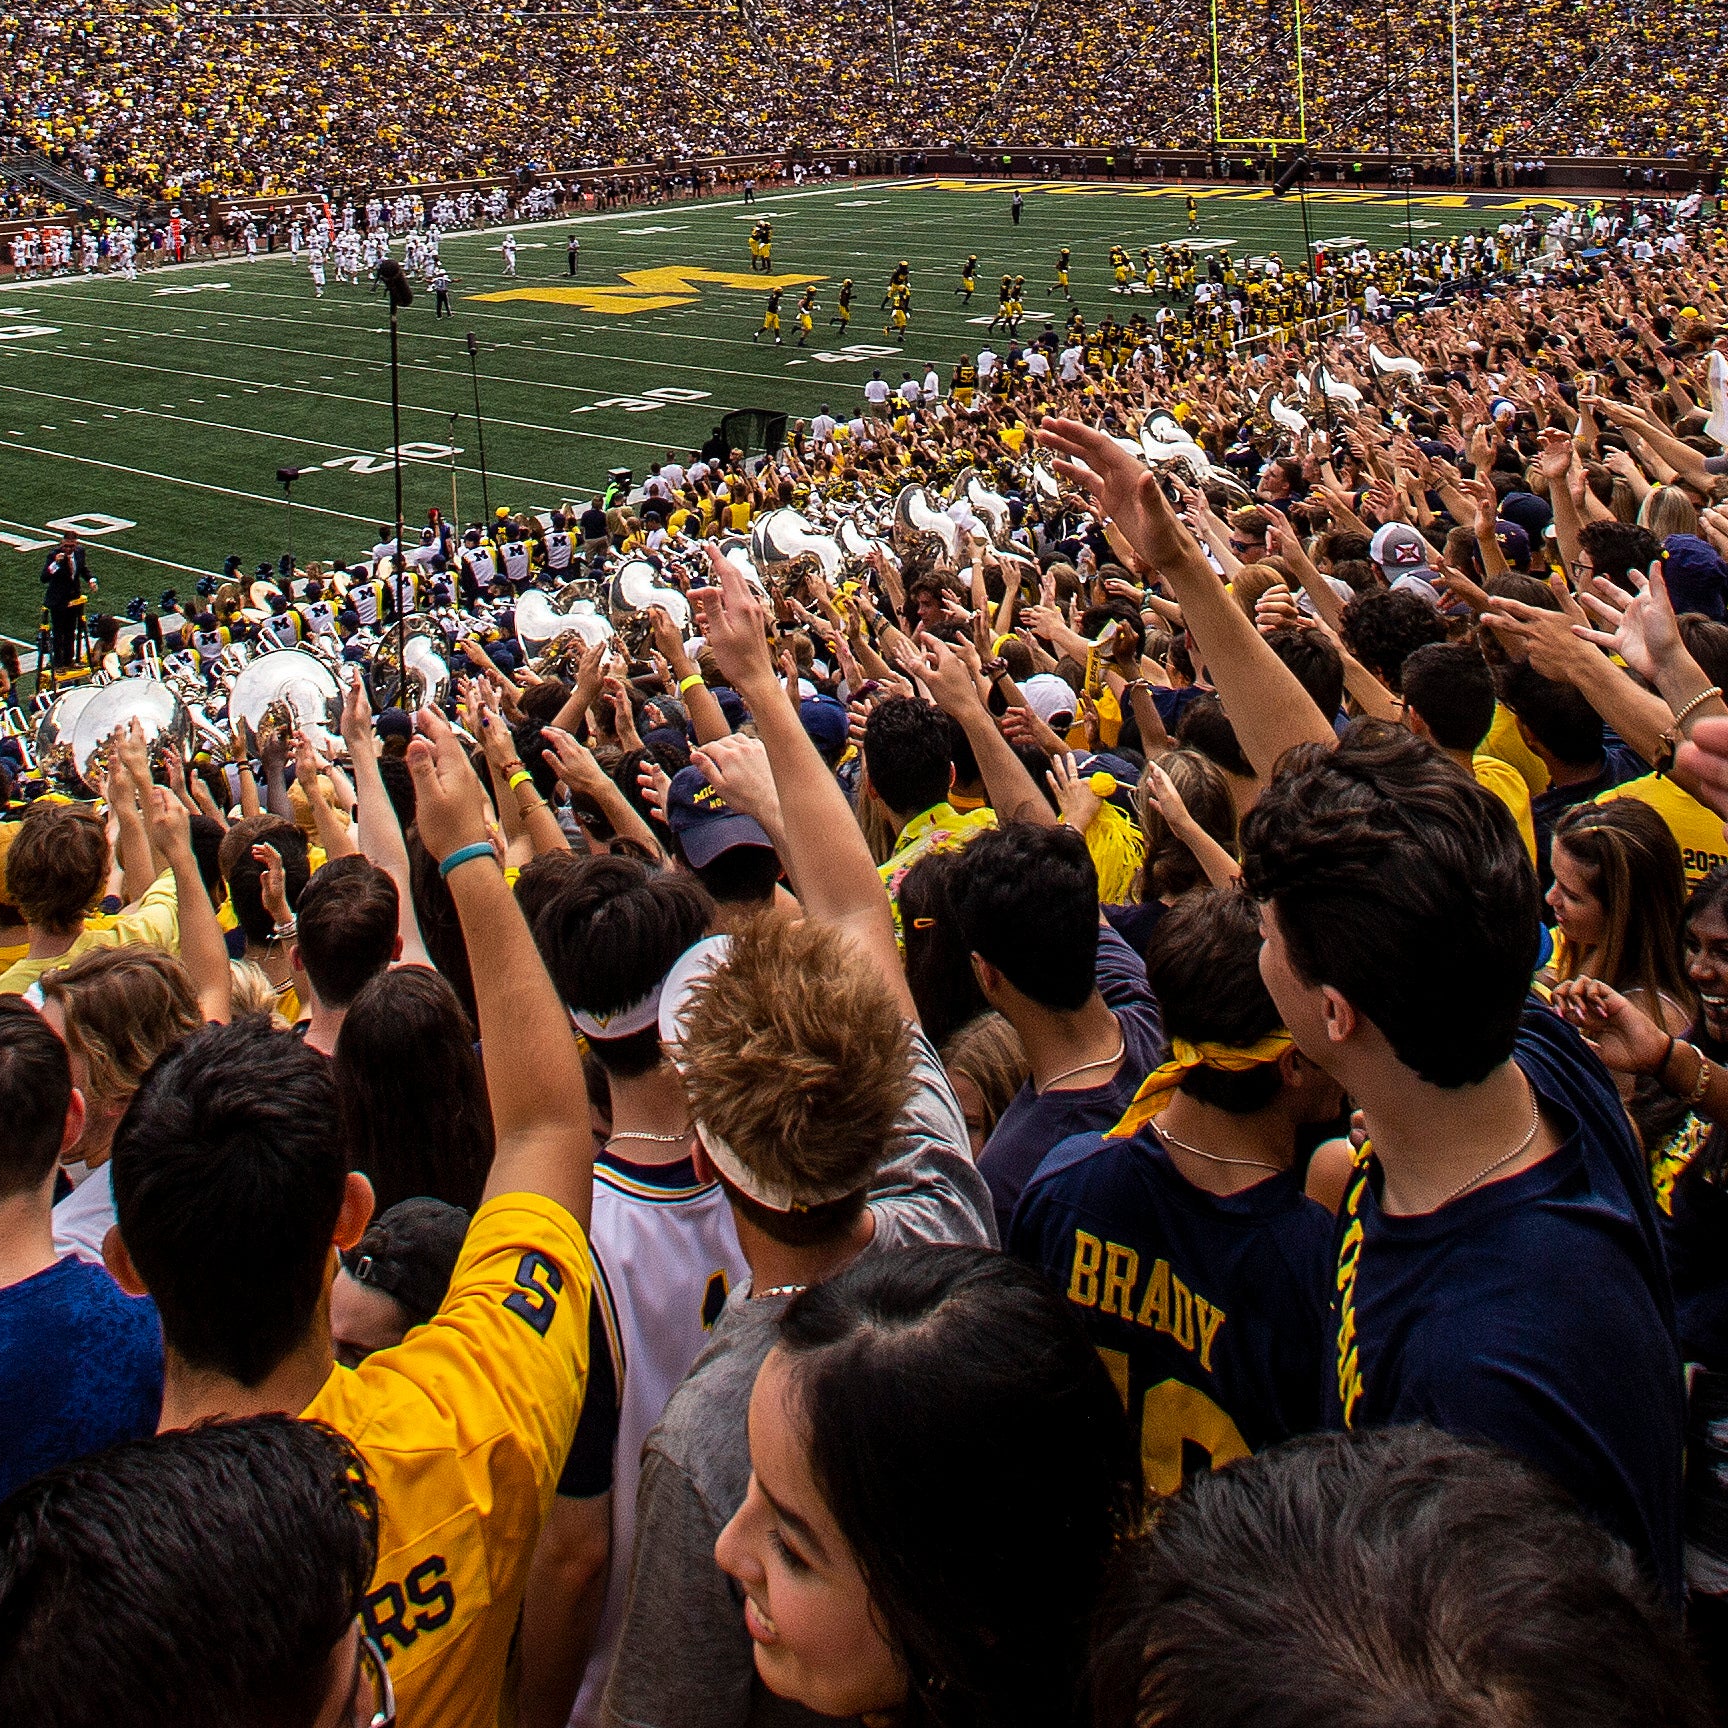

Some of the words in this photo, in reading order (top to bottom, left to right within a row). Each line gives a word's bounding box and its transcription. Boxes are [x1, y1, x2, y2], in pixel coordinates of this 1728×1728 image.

[886, 180, 1614, 212] MICHIGAN
[462, 265, 831, 314] M
[593, 387, 713, 412] 30
[322, 441, 465, 474] 20
[553, 536, 568, 547] M
[474, 550, 489, 561] M
[509, 545, 524, 557] M
[359, 587, 376, 600] M
[312, 604, 328, 615] M
[272, 618, 290, 632] M
[200, 633, 217, 645] M
[693, 784, 716, 803] MIC
[1066, 1228, 1226, 1373] BRADY
[360, 1555, 456, 1660] RS
